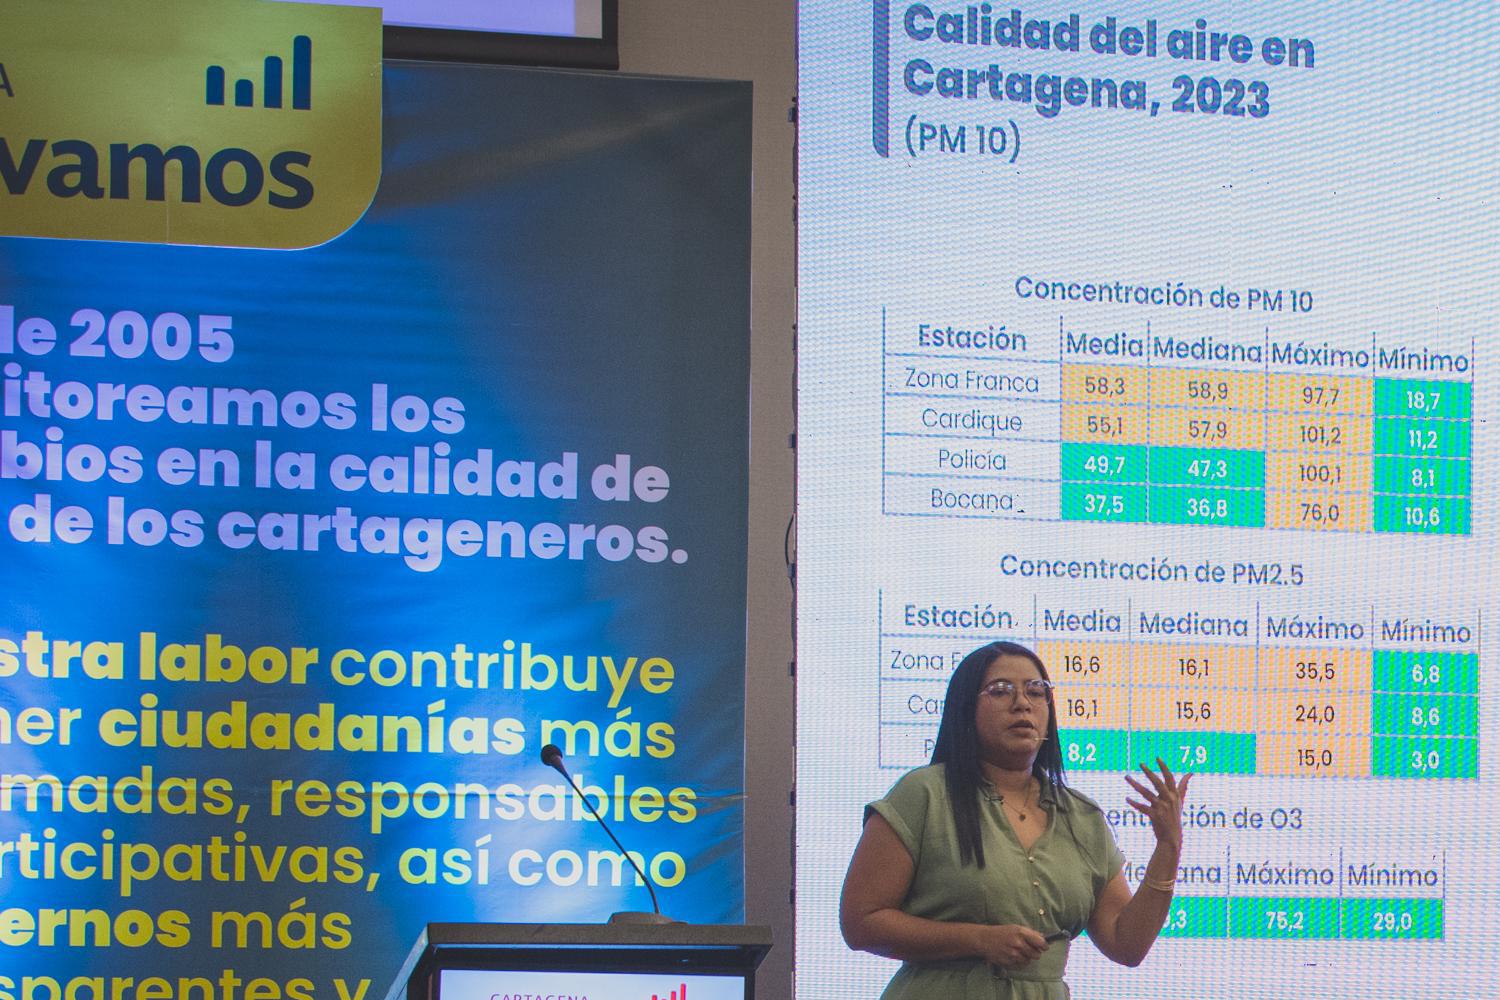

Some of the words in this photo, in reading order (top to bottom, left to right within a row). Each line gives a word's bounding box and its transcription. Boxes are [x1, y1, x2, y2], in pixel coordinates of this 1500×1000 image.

[904, 3, 1079, 52] Calidad
[1089, 16, 1157, 57] del
[1167, 19, 1254, 64] aire
[1262, 36, 1315, 68] en
[904, 59, 1160, 118] Cartagena,
[1171, 75, 1270, 118] 2023
[904, 114, 966, 157] (PM
[976, 119, 1020, 163] 10)
[1014, 276, 1205, 309] Concentración
[1210, 286, 1240, 309] de
[1248, 289, 1283, 311] PM
[1290, 290, 1313, 312] 10
[69, 309, 235, 363] 2005
[918, 324, 1027, 350] Estación
[1066, 332, 1143, 356] Media
[1153, 336, 1262, 363] Mediana
[1272, 342, 1369, 367] Máximo
[1379, 347, 1469, 372] Mínimo
[371, 383, 466, 434] los
[904, 368, 959, 389] Zona
[966, 370, 1039, 392] Franca
[1084, 376, 1125, 396] 58,3
[1188, 381, 1228, 402] 58,9
[1303, 387, 1339, 408] 97,7
[1407, 391, 1440, 411] 18,7
[922, 408, 1022, 436] Cardique
[1087, 416, 1122, 437] 55,1
[1189, 421, 1227, 441] 57,9
[1301, 426, 1341, 447] 101,2
[1409, 429, 1437, 450] 11,2
[157, 444, 239, 488] en
[256, 439, 315, 490] la
[329, 441, 578, 501] calidad
[591, 454, 669, 503] de
[938, 448, 1006, 470] Policía
[1084, 456, 1125, 476] 49,7
[1188, 460, 1227, 480] 47,3
[1299, 465, 1341, 485] 100,1
[1411, 469, 1435, 488] 8,1
[9, 494, 93, 543] de
[108, 496, 205, 548] los
[217, 506, 689, 572] cartageneros.
[931, 488, 1013, 510] Bocana
[1084, 494, 1124, 514] 37,5
[1187, 499, 1228, 519] 36,8
[1301, 503, 1339, 524] 76,0
[1405, 506, 1440, 527] 10,6
[139, 631, 318, 686] labor
[331, 640, 676, 708] contribuye
[98, 694, 525, 756] ciudadanías
[540, 706, 676, 759] más
[270, 774, 698, 834] responsables
[399, 839, 489, 888] así
[508, 848, 686, 889] como
[211, 898, 352, 951] más
